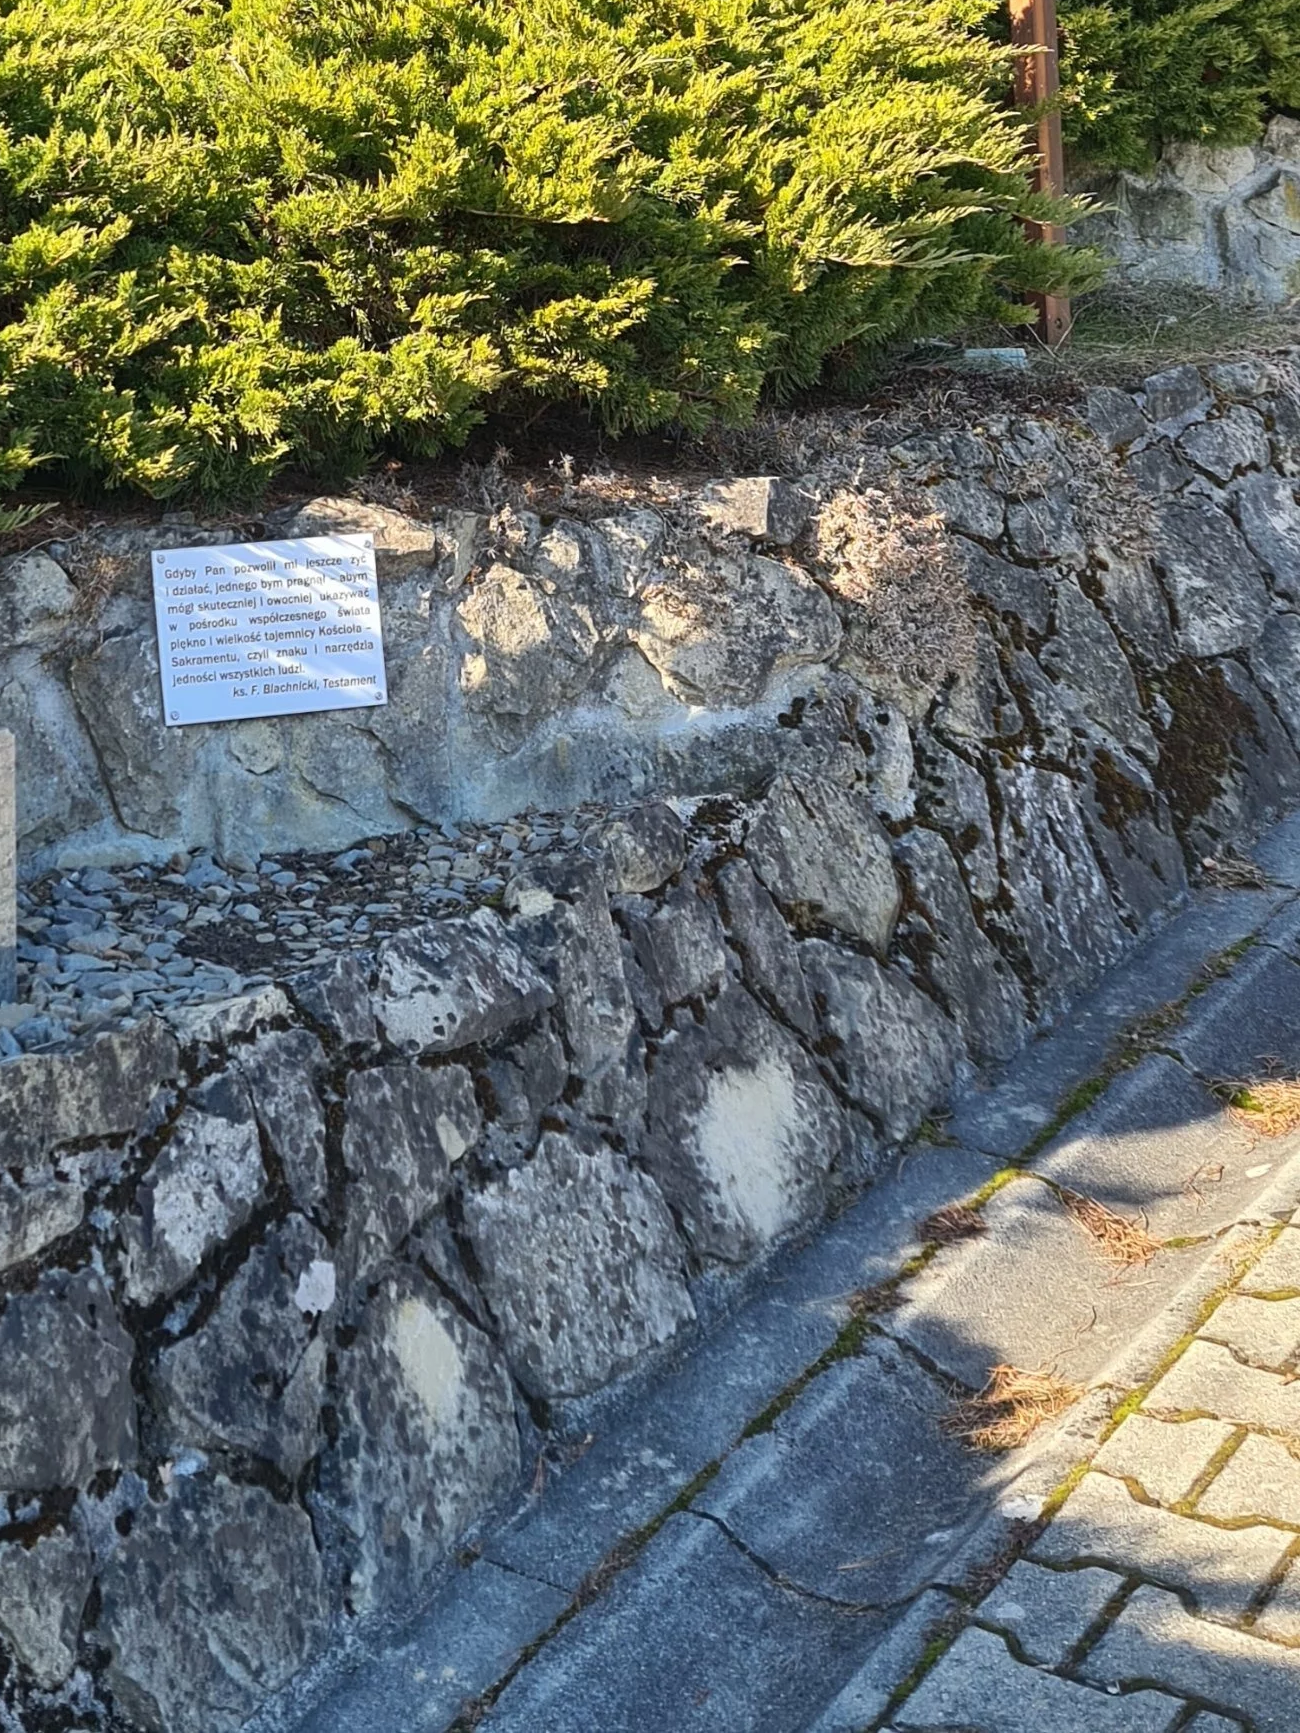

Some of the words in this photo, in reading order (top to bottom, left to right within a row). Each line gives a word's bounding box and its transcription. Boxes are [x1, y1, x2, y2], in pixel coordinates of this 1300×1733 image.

[164, 568, 196, 580] Gdyby
[205, 566, 225, 575] Pan
[234, 560, 276, 576] pozwolił
[284, 559, 298, 569] mi
[306, 557, 342, 569] jeszcze
[172, 583, 212, 596] działać,
[215, 581, 257, 594] jednego
[261, 579, 283, 590] bym
[340, 572, 368, 583] abym
[168, 602, 194, 615] mógł
[197, 597, 256, 611] skuteczniej
[267, 592, 312, 606] owocniej
[320, 587, 370, 601] ukazywać
[169, 624, 178, 632] w
[189, 617, 237, 632] pośrodku
[248, 610, 327, 625] współczesnego
[337, 606, 370, 618] świata
[170, 637, 206, 651] piękno
[215, 630, 261, 645] wielkość
[264, 627, 315, 642] tajemnicy
[319, 624, 362, 636] Kościoła
[171, 653, 240, 667] Sakramentu,
[247, 648, 269, 662] czyli
[276, 646, 307, 658] znaku
[325, 640, 374, 653] narzędzia
[172, 671, 217, 687] jedności
[219, 666, 275, 681] wszystkich
[278, 663, 305, 675] ludzi.
[233, 686, 248, 697] ks.
[251, 684, 260, 695] F.
[263, 680, 320, 694] Blachnicki,
[323, 675, 377, 689] Testament
